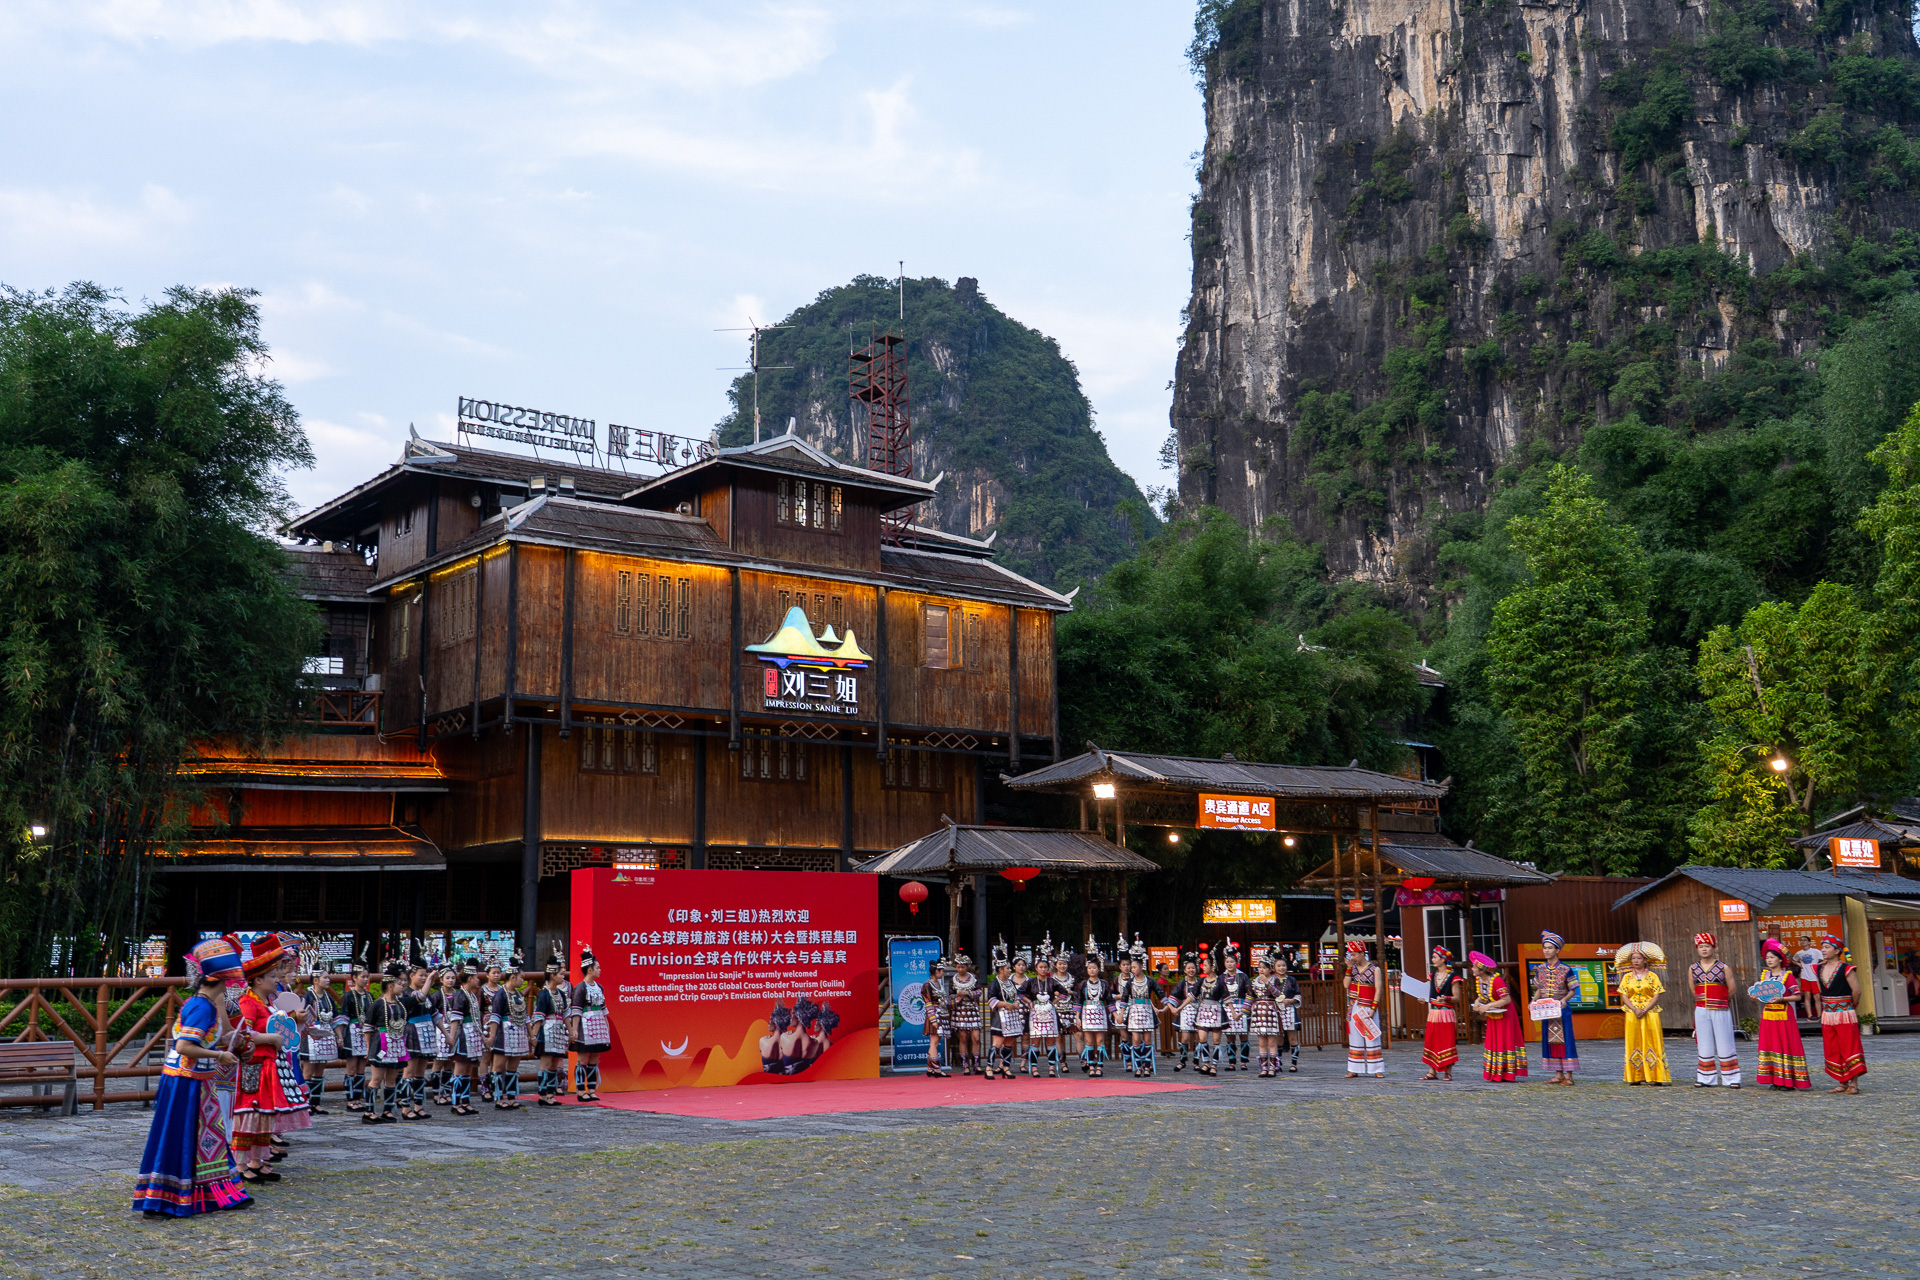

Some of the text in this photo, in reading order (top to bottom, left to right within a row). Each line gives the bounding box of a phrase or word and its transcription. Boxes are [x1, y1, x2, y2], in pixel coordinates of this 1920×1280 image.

[783, 669, 858, 703] 刘三姐
[766, 699, 858, 714] IMPRESSION SANJIE LIU
[1205, 799, 1270, 817] 贵宾通道 A区
[1839, 839, 1874, 857] 取票处
[667, 909, 810, 923] 《印象·刘三姐》热烈欢迎
[1722, 904, 1746, 913] 取票处
[613, 930, 857, 945] 2026全球跨境旅游（桂林）大会暨携程集团
[630, 950, 847, 966] Envision全球合作伙伴大会与会嘉宾
[659, 972, 705, 981] "Impression
[719, 971, 746, 980] Sanjie"
[755, 970, 781, 979] warmly
[619, 984, 645, 992] Guests
[647, 983, 683, 992] attending
[718, 982, 742, 990] Global
[743, 981, 789, 990] Cross-Border
[791, 980, 818, 988] Tourism
[820, 980, 845, 988] (Guilin)
[619, 994, 662, 1002] Conference
[680, 993, 699, 1002] Ctrip
[700, 992, 729, 1001] Group's
[786, 990, 812, 998] Partner
